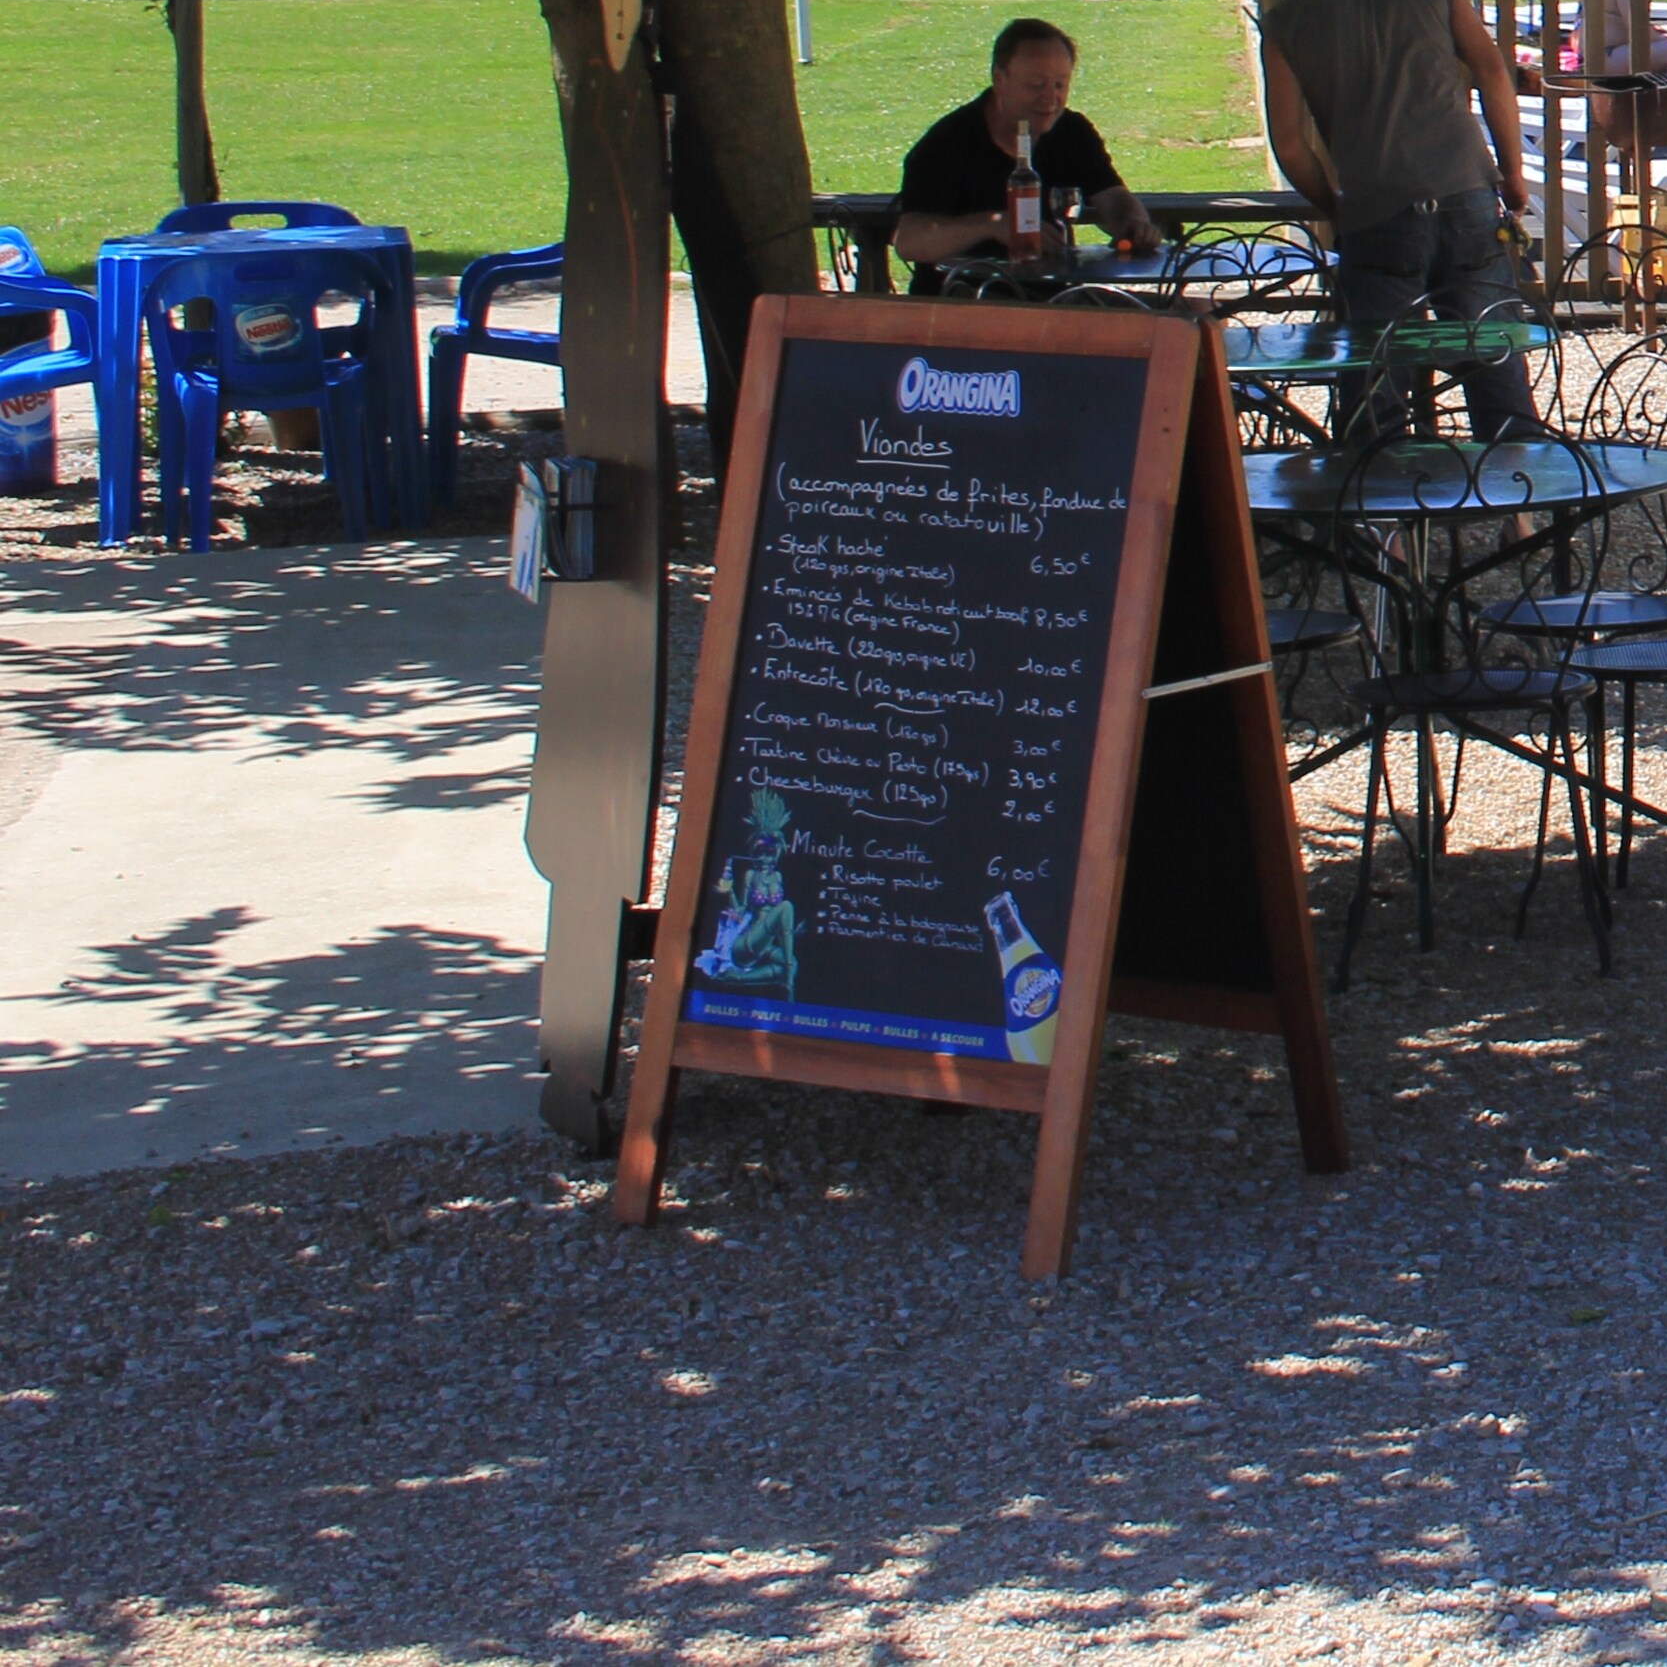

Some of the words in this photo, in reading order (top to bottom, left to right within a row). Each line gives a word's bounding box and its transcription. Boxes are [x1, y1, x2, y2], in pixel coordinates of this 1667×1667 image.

[861, 418, 953, 456] Viandes
[785, 498, 876, 522] poireaux
[883, 509, 908, 524] ou
[937, 480, 959, 502] de
[969, 478, 1036, 512] frites,
[1040, 487, 1104, 517] fondue
[1108, 487, 1127, 509] de
[837, 535, 888, 556] haché
[852, 588, 873, 607] de
[884, 592, 933, 613] Kebab
[766, 622, 841, 655] Bavette
[764, 657, 849, 691] Entrecôte
[754, 702, 811, 729] Croque
[744, 737, 807, 762] Tartine
[749, 766, 873, 806] Cheeseburger
[791, 829, 854, 858] Minute
[863, 839, 933, 864] Cocotte
[832, 864, 886, 886] Risotto
[893, 874, 944, 891] poulet
[792, 1013, 829, 1028] BULLES
[840, 1020, 871, 1033] PULPE
[883, 1024, 919, 1040] BULLES
